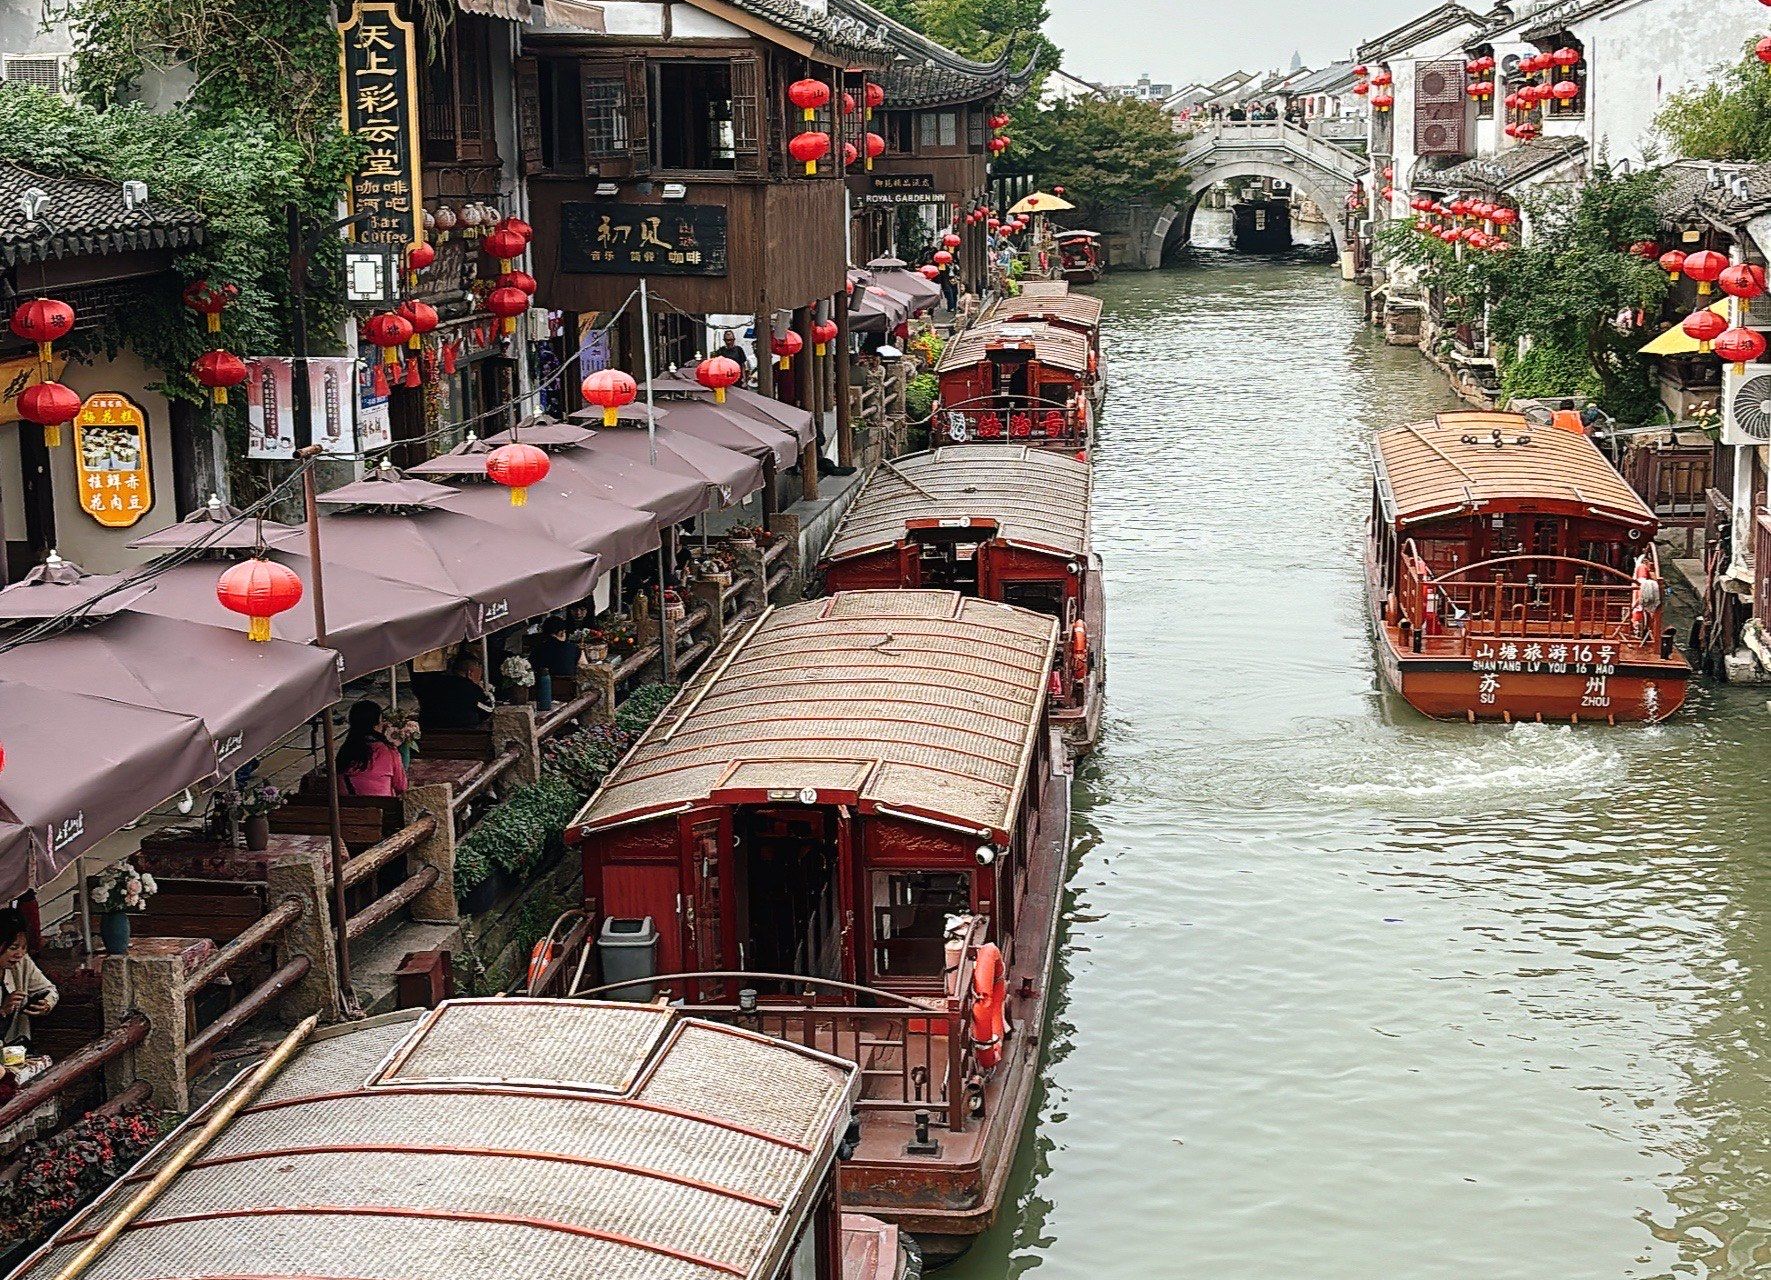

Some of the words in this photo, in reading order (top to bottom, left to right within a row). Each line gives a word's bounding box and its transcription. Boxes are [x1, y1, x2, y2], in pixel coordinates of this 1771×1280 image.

[353, 25, 402, 177] 天上彩云堂
[355, 180, 409, 195] 咖啡
[866, 194, 893, 202] ROYAL
[895, 193, 931, 202] GARDEN
[932, 193, 946, 202] INN
[590, 250, 615, 261] 音乐
[668, 251, 701, 264] 咖啡
[1476, 643, 1616, 664] 山塘旅游16号
[1528, 662, 1541, 672] LV
[1549, 662, 1567, 674] YOU
[1576, 663, 1587, 674] 16
[1595, 664, 1615, 675] HAO
[1479, 672, 1501, 693] 苏
[1584, 675, 1607, 696] 州
[1479, 693, 1496, 704] SU
[1581, 696, 1610, 707] ZHOU
[803, 790, 814, 801] 12
